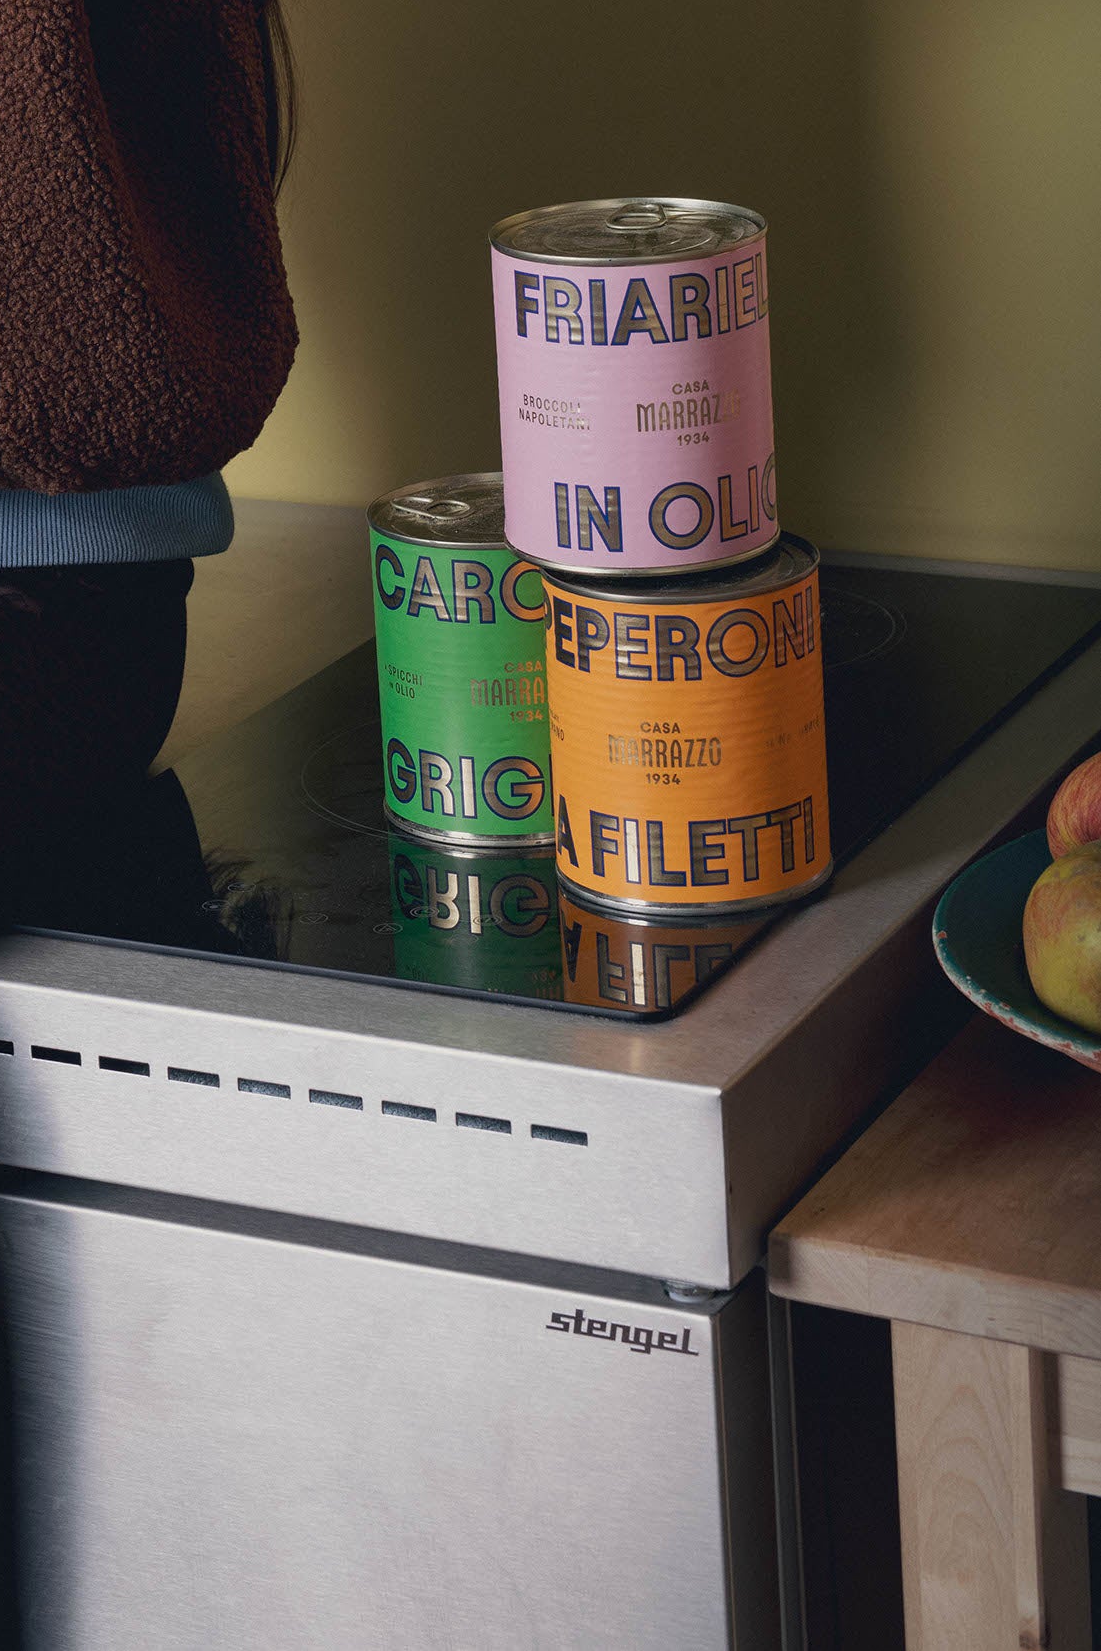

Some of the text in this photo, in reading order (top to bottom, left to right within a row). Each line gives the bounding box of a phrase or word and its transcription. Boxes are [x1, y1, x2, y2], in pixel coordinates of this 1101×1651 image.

[513, 252, 769, 347] FRIARIEL
[672, 379, 710, 395] CASA
[523, 393, 582, 414] BROCCOLI
[677, 432, 711, 447] 1934
[554, 481, 624, 553] IN
[546, 585, 816, 682] EPERONI
[387, 664, 423, 686] SPICCHI
[504, 661, 543, 674] CASA
[395, 682, 415, 699] OLIO
[470, 677, 546, 707] MARRA
[510, 710, 544, 723] 1934
[640, 722, 681, 735] CASA
[608, 734, 722, 769] MARRAZZO
[386, 737, 556, 820] GRIG
[645, 773, 681, 786] 1934
[589, 796, 815, 888] FILETTI
[546, 1308, 699, 1356] stengel
